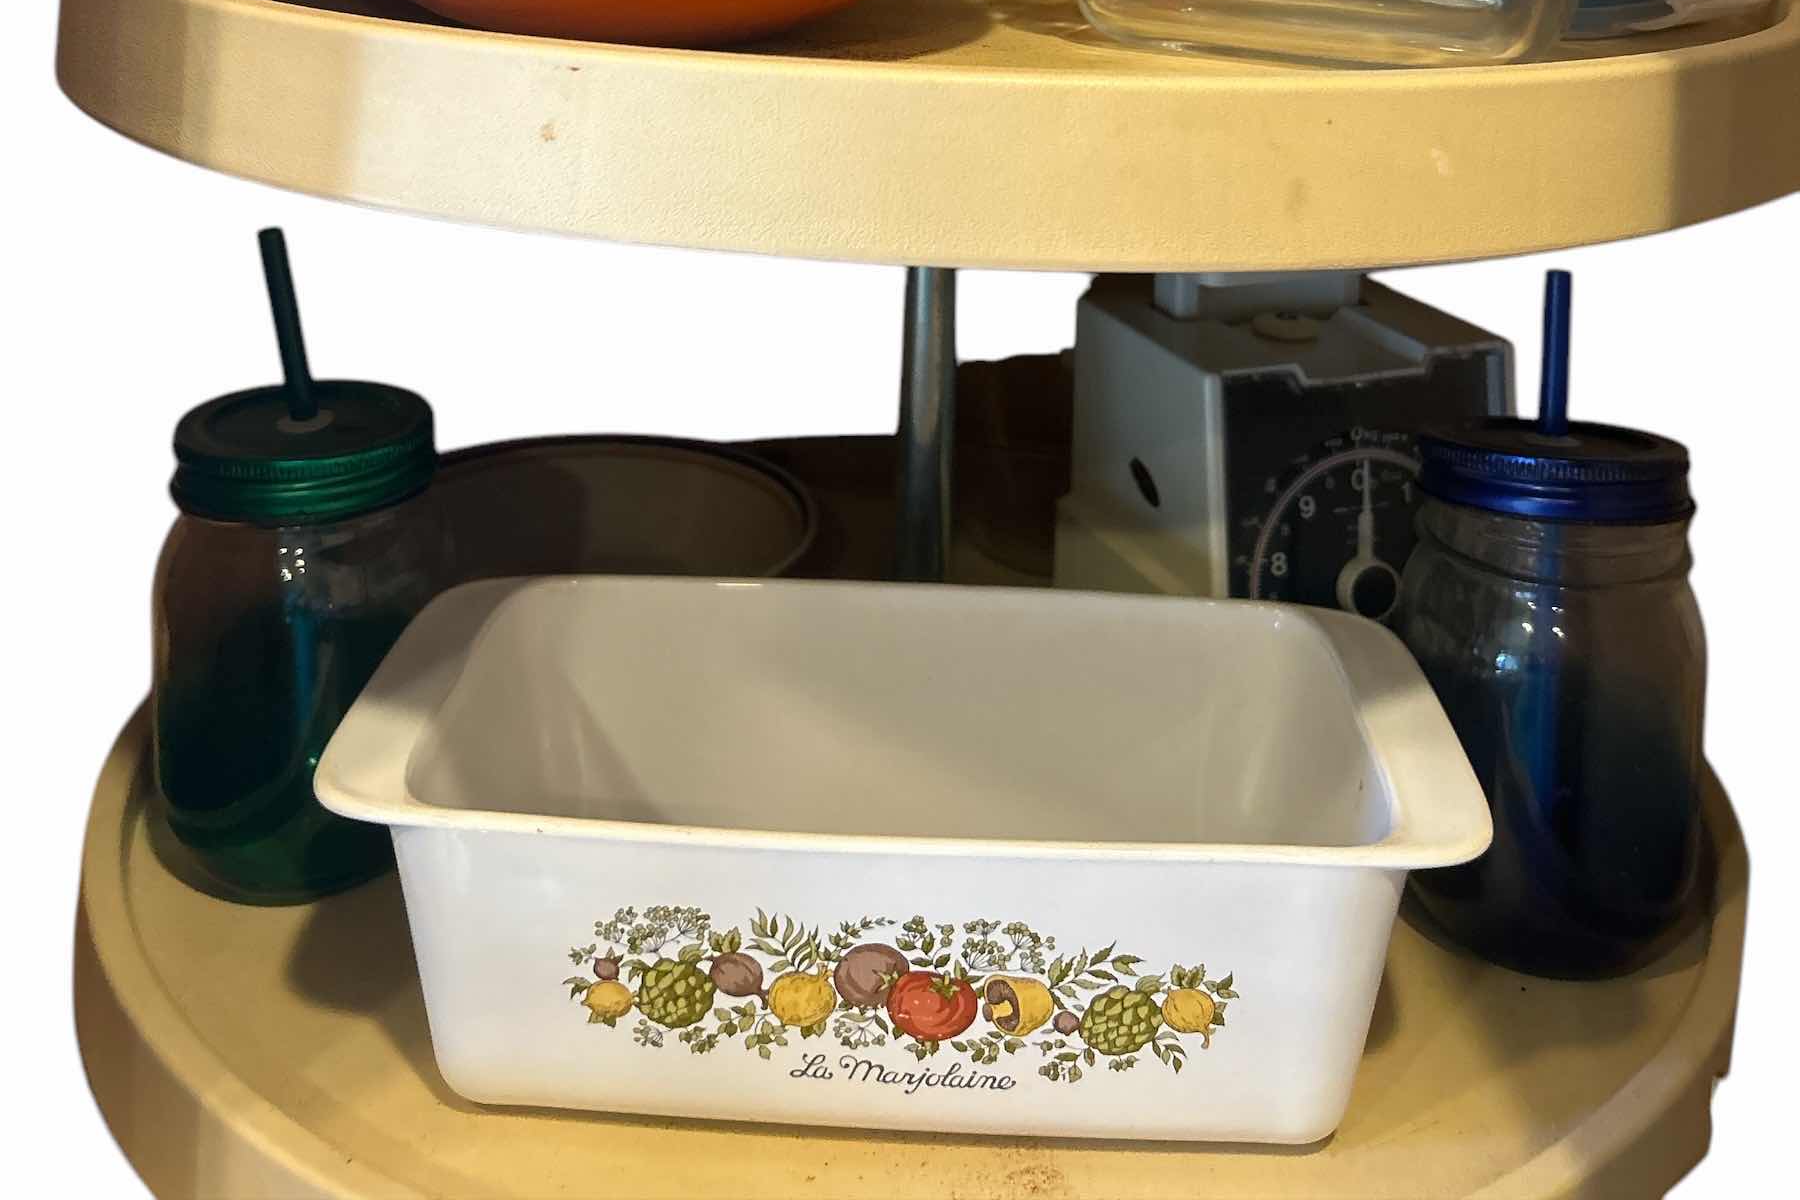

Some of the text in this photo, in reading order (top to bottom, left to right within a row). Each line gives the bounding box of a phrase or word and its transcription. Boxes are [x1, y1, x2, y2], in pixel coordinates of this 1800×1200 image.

[1299, 495, 1316, 519] 9
[1270, 552, 1288, 576] 8
[789, 1054, 1017, 1094] La Marjolaine
